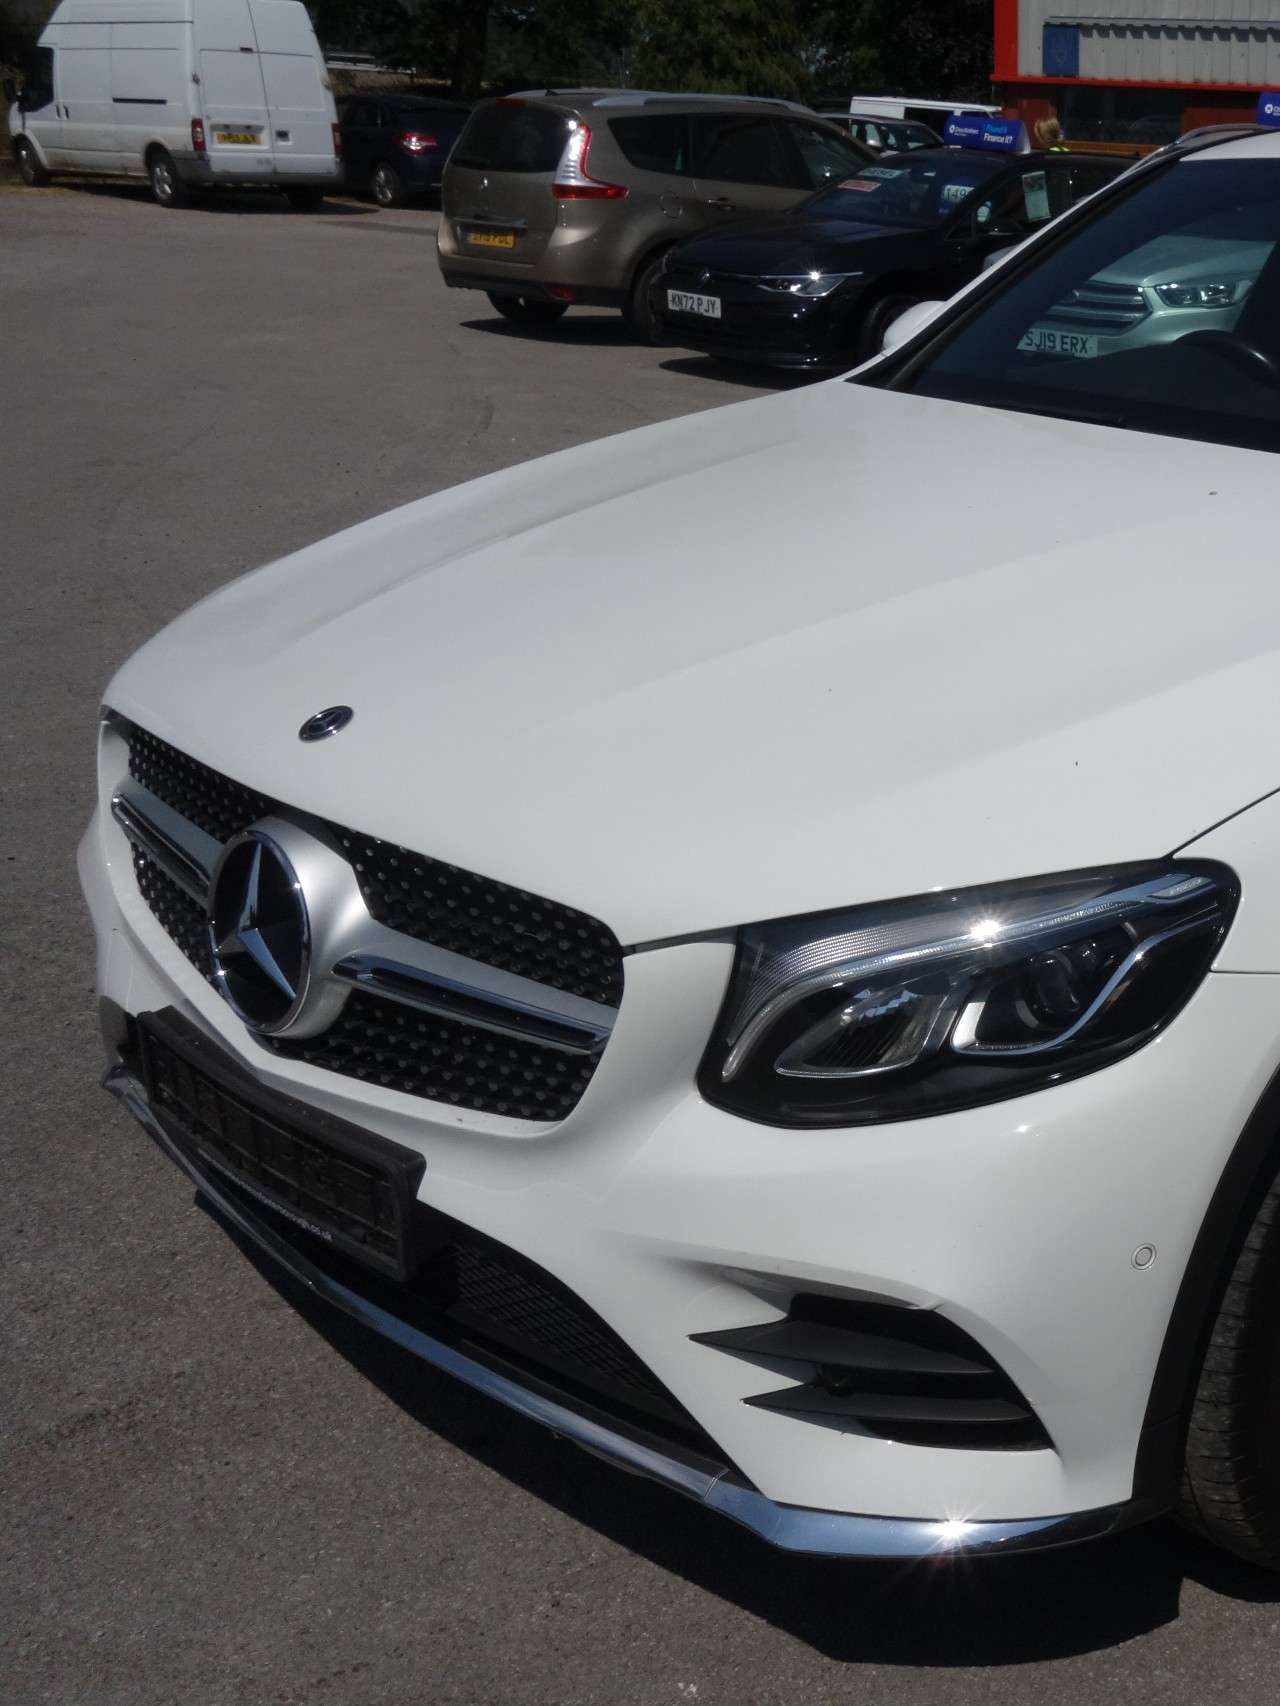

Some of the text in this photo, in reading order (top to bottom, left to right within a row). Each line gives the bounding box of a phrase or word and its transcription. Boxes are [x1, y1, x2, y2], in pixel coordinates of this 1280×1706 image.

[671, 292, 716, 313] KN72 PJY
[1025, 330, 1088, 353] SJ19 ERX
